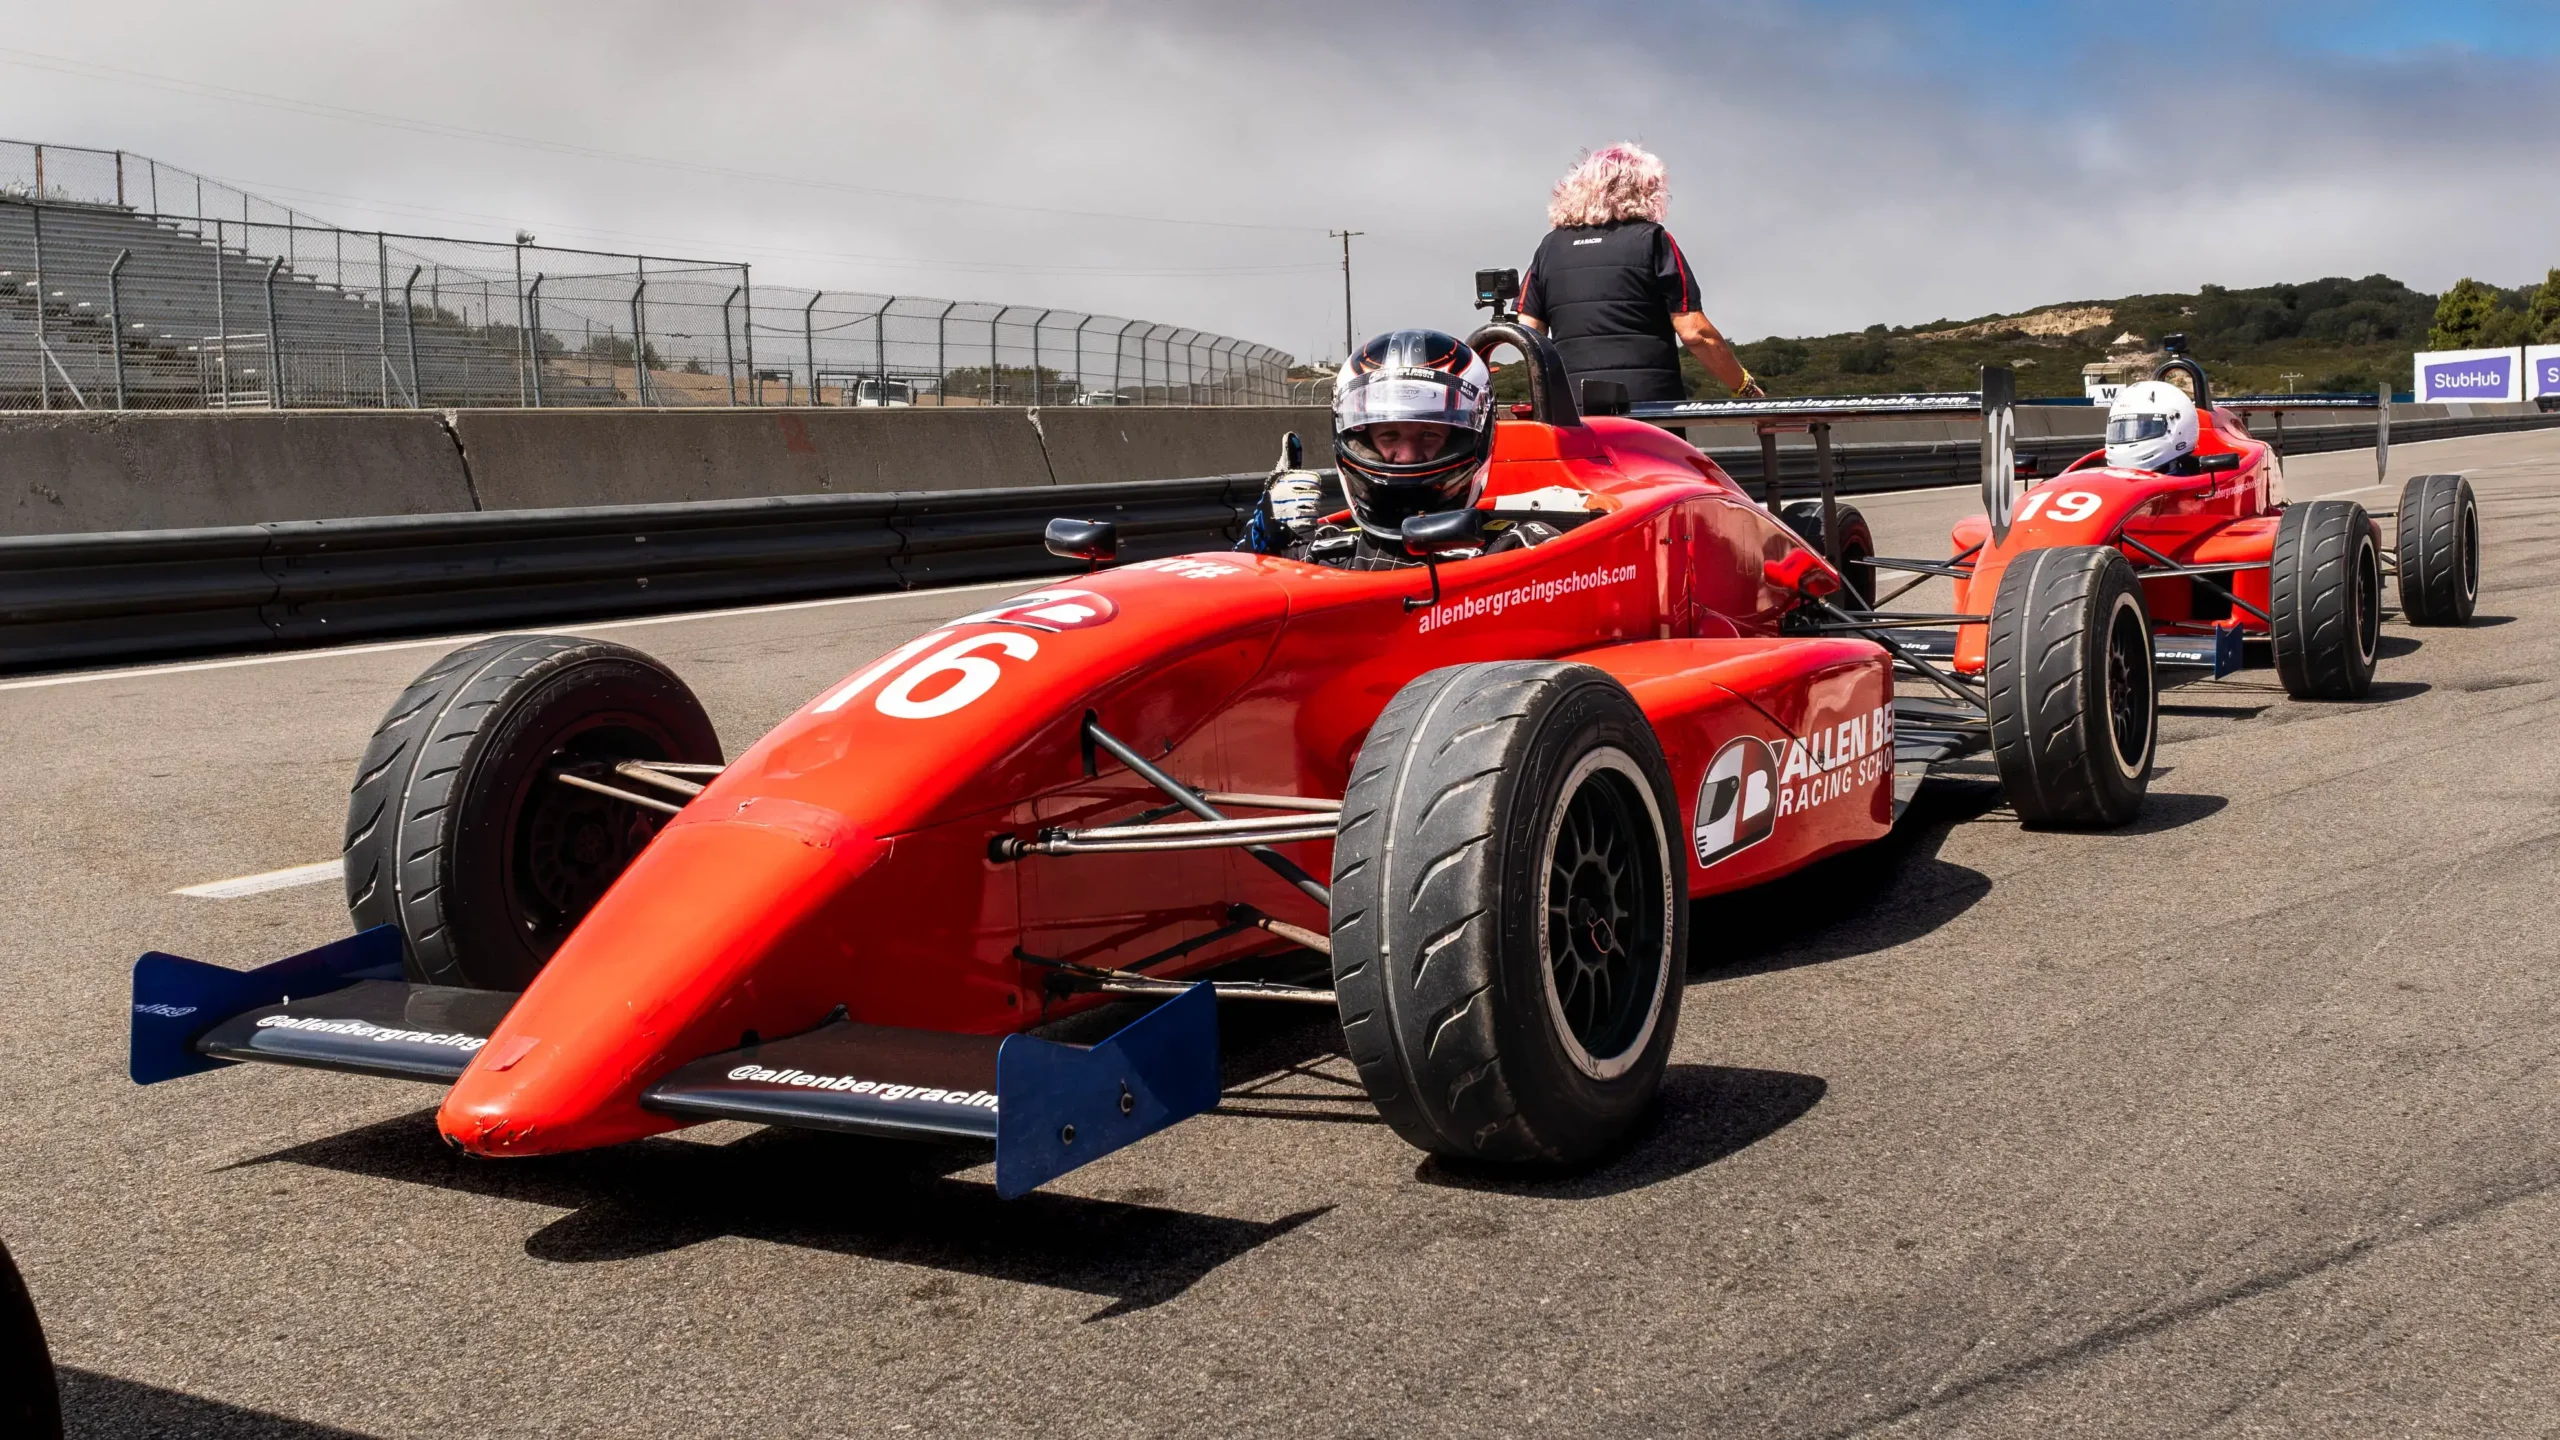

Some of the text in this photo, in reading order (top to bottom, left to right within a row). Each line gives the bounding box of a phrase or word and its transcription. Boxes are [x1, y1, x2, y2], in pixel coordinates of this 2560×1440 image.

[2434, 371, 2501, 389] StubHub
[2547, 367, 2560, 383] S
[1672, 396, 1970, 411] allenbergracingschools.com
[1988, 406, 2015, 528] 16
[2016, 491, 2103, 523] 19
[1418, 564, 1637, 634] allenbergracingschools.com
[811, 630, 1039, 720] 16
[1779, 702, 1894, 785] ALLEN BE
[1777, 746, 1894, 818] RACING SCHO
[256, 1015, 489, 1051] @allenbergracing
[727, 1065, 998, 1113] @allenbergracin
